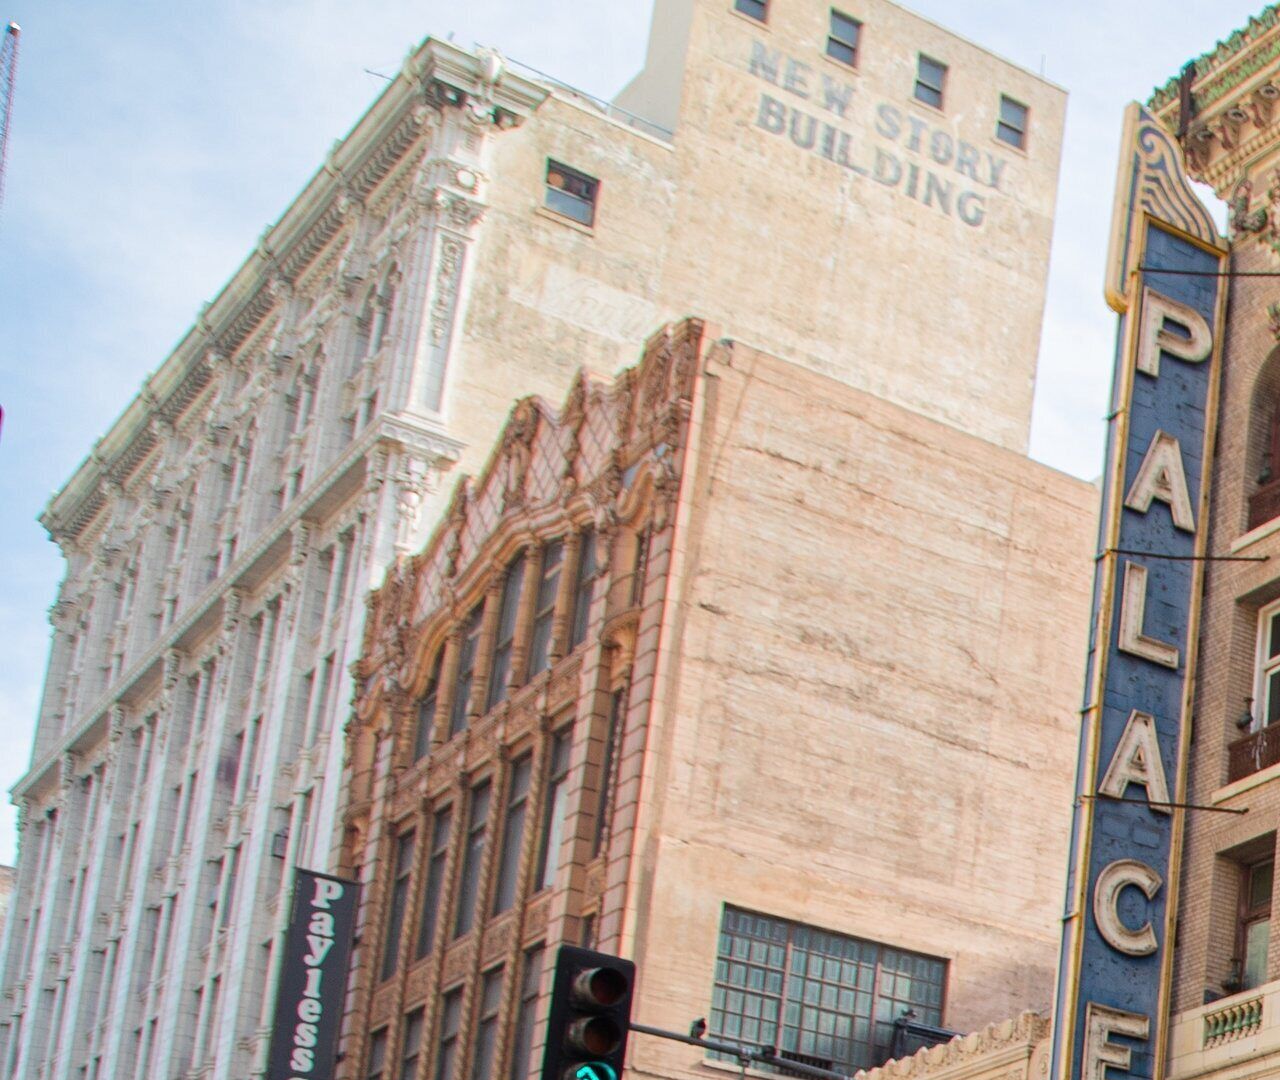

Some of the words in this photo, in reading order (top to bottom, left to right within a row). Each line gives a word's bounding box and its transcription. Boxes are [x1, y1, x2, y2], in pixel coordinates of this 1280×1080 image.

[748, 37, 858, 119] NEW
[874, 101, 1009, 192] STORY
[754, 93, 988, 228] BUILDING
